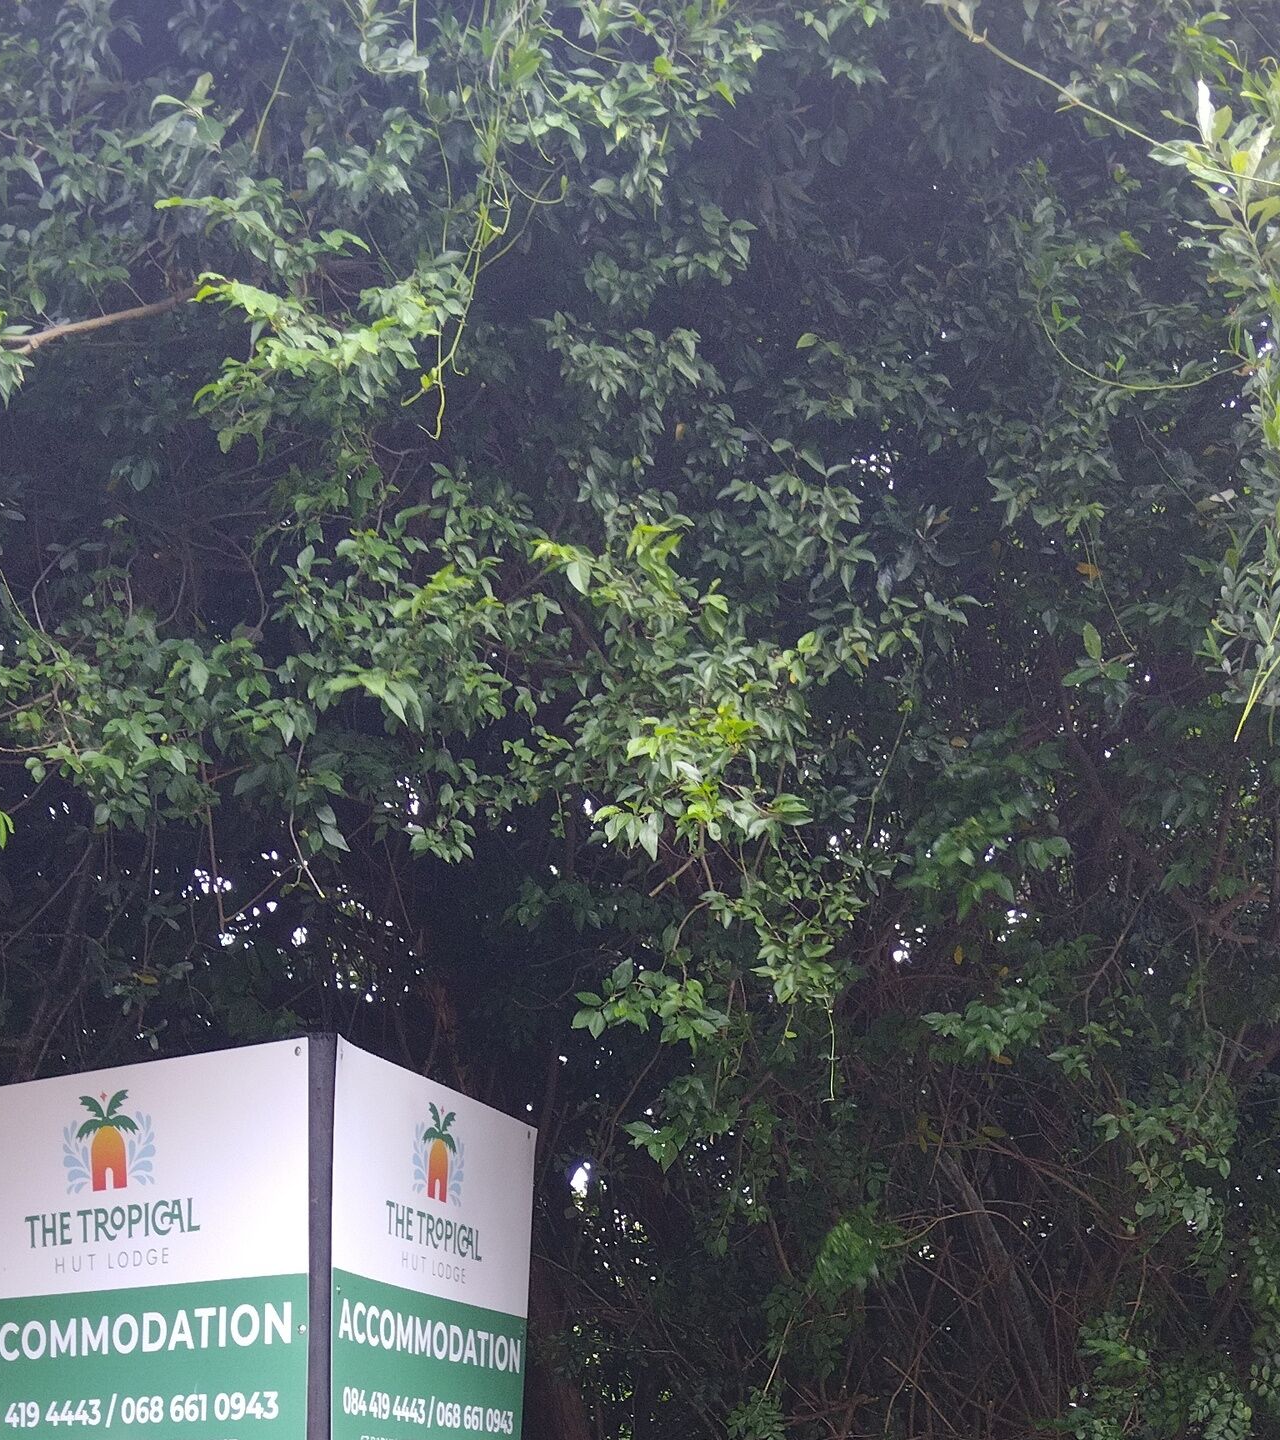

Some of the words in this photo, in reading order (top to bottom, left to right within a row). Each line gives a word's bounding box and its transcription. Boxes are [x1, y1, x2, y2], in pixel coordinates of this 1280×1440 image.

[25, 1211, 72, 1248] THE
[78, 1198, 201, 1241] TROPICAL
[386, 1201, 413, 1241] THE
[417, 1211, 482, 1261] TROPICAL
[55, 1254, 97, 1274] HUT
[107, 1247, 169, 1269] LODGE
[401, 1252, 427, 1272] HUT
[432, 1260, 466, 1284] LODGE
[339, 1298, 521, 1373] ACCOMMODATION
[4, 1402, 39, 1428] 419
[45, 1399, 101, 1426] 4443
[105, 1393, 118, 1428] /
[121, 1396, 164, 1424] 068
[170, 1394, 208, 1422] 661
[214, 1391, 278, 1421] 0943
[343, 1386, 366, 1416] 084
[369, 1392, 389, 1419] 419
[393, 1396, 425, 1424] 4443
[427, 1396, 435, 1428] /
[437, 1402, 460, 1428] 068
[464, 1406, 483, 1431] 661
[486, 1409, 513, 1434] 0943
